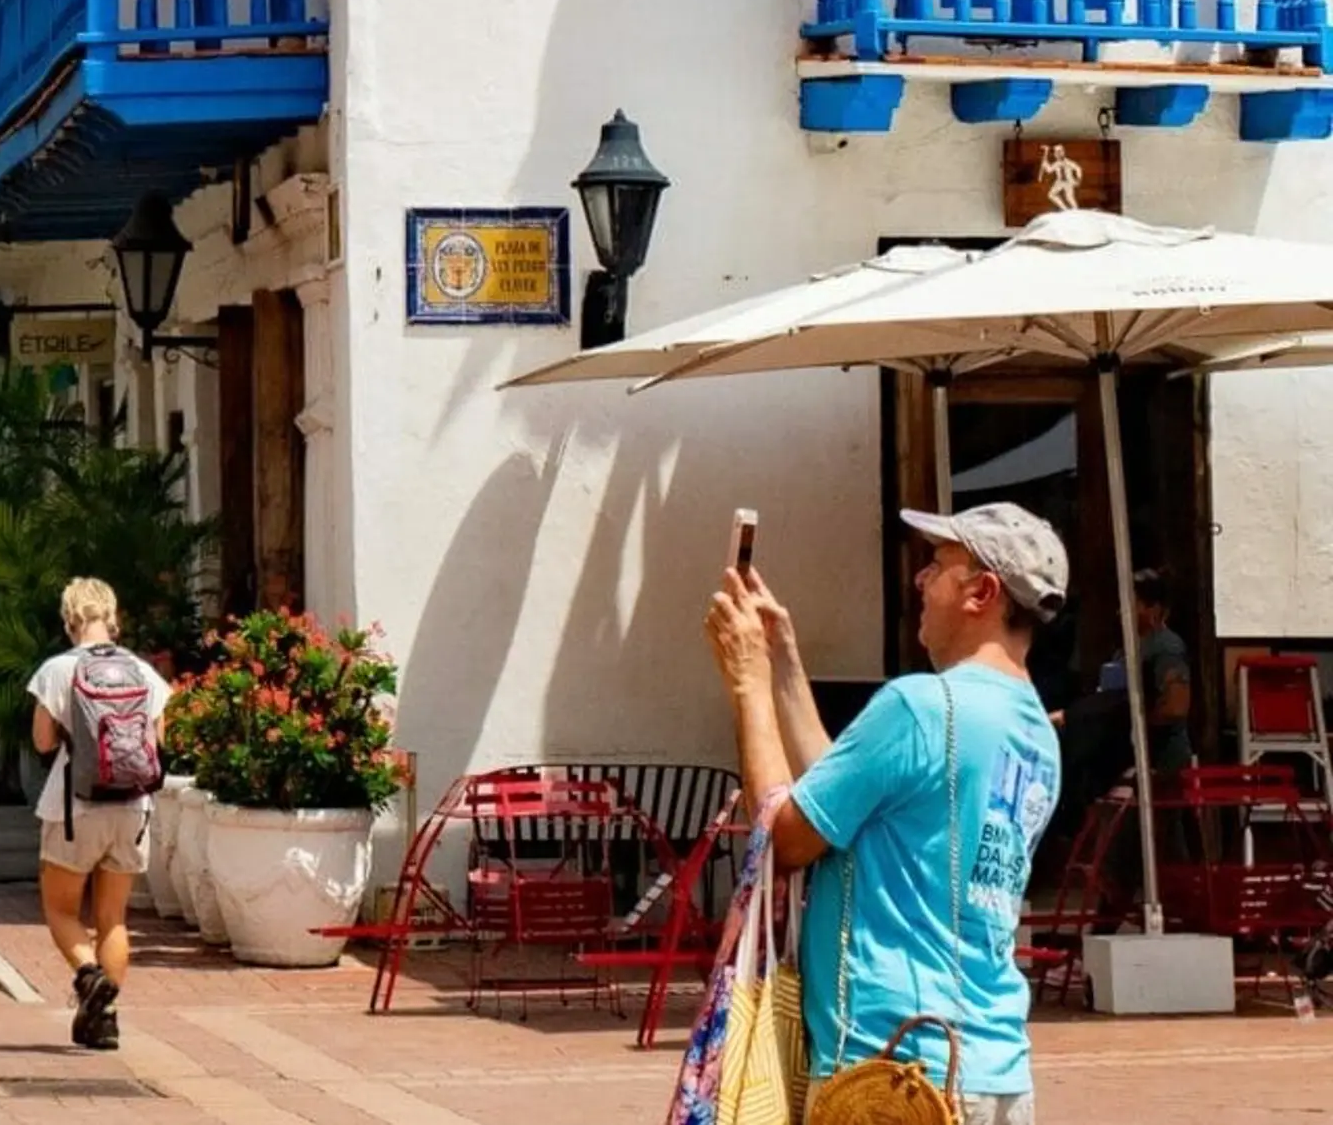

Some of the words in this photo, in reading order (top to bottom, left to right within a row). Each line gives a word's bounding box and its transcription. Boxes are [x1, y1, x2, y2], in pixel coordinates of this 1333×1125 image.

[495, 241, 525, 255] PLAZA
[529, 241, 541, 255] DE
[513, 259, 546, 273] PEDRO
[499, 278, 537, 293] CLAVER
[977, 845, 1025, 875] DAS
